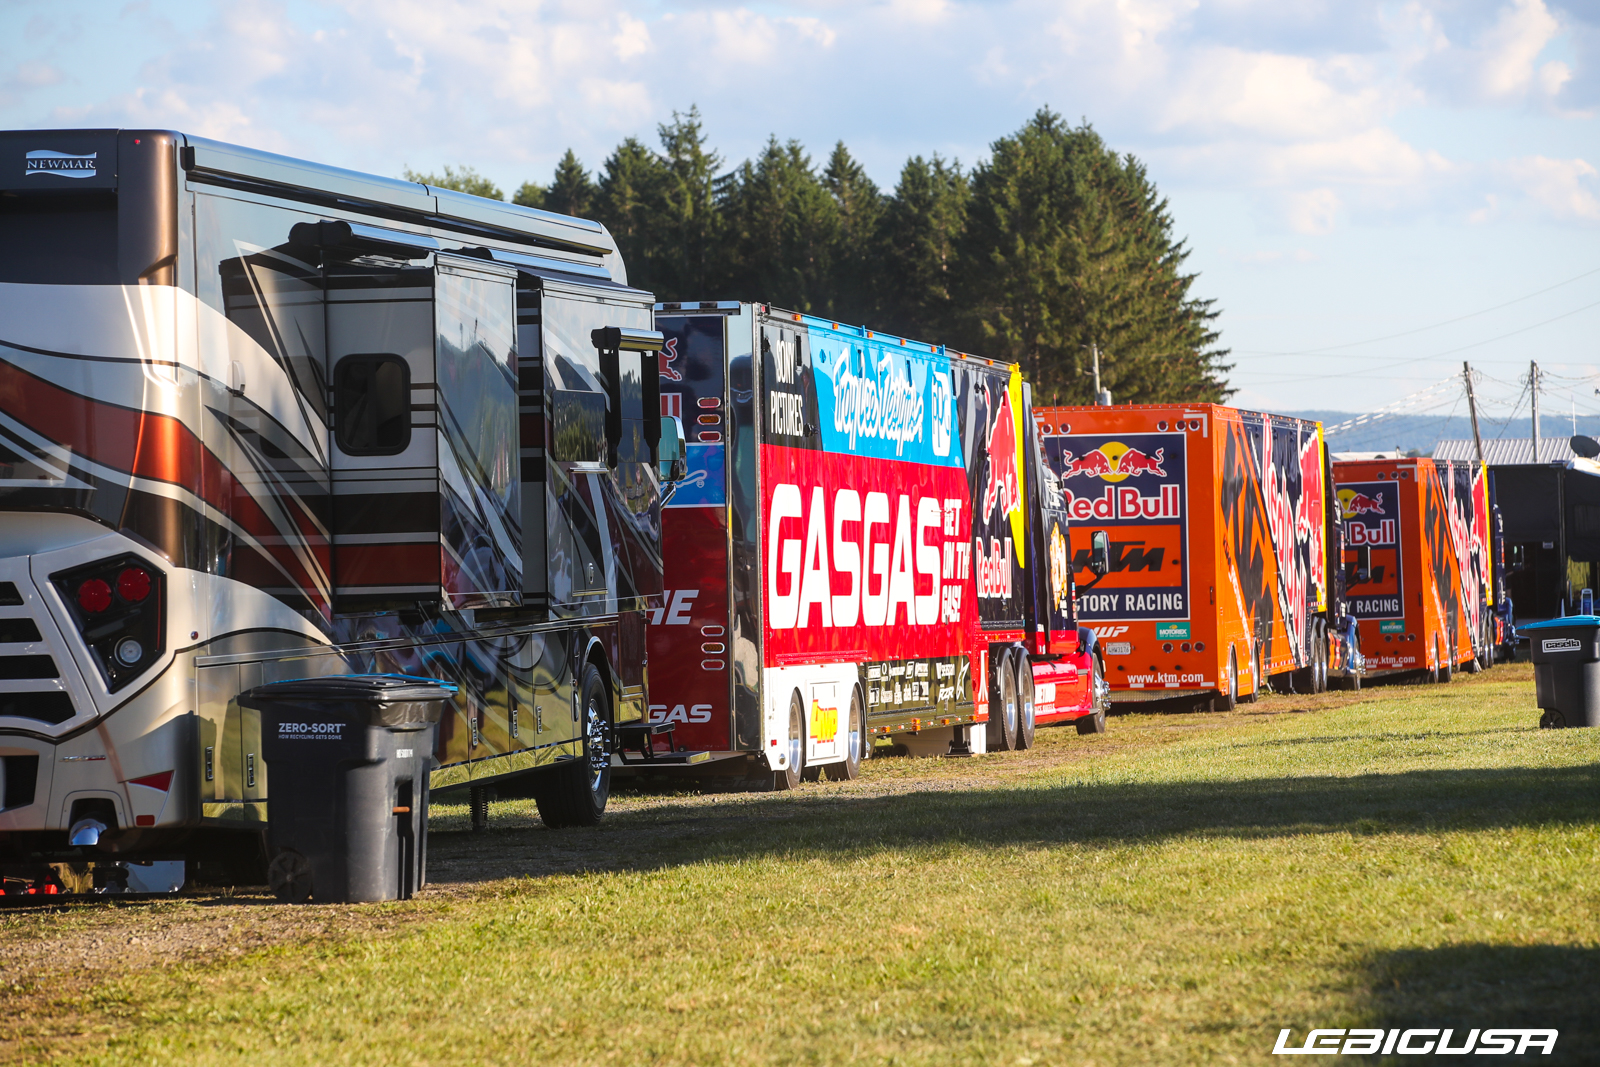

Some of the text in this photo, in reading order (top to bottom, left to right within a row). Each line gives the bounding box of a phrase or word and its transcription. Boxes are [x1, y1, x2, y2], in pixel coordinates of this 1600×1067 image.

[27, 159, 96, 169] NEWMAR
[776, 339, 795, 385] SONY
[770, 390, 803, 437] PICTURES
[1117, 484, 1180, 520] Bull
[1349, 519, 1396, 546] Bull
[768, 483, 941, 630] GASGAS
[943, 541, 955, 579] ON
[976, 536, 1012, 599] Red Bull
[1125, 593, 1183, 611] RACING
[1356, 599, 1399, 613] RACING
[1127, 672, 1204, 684] www.ktm.com
